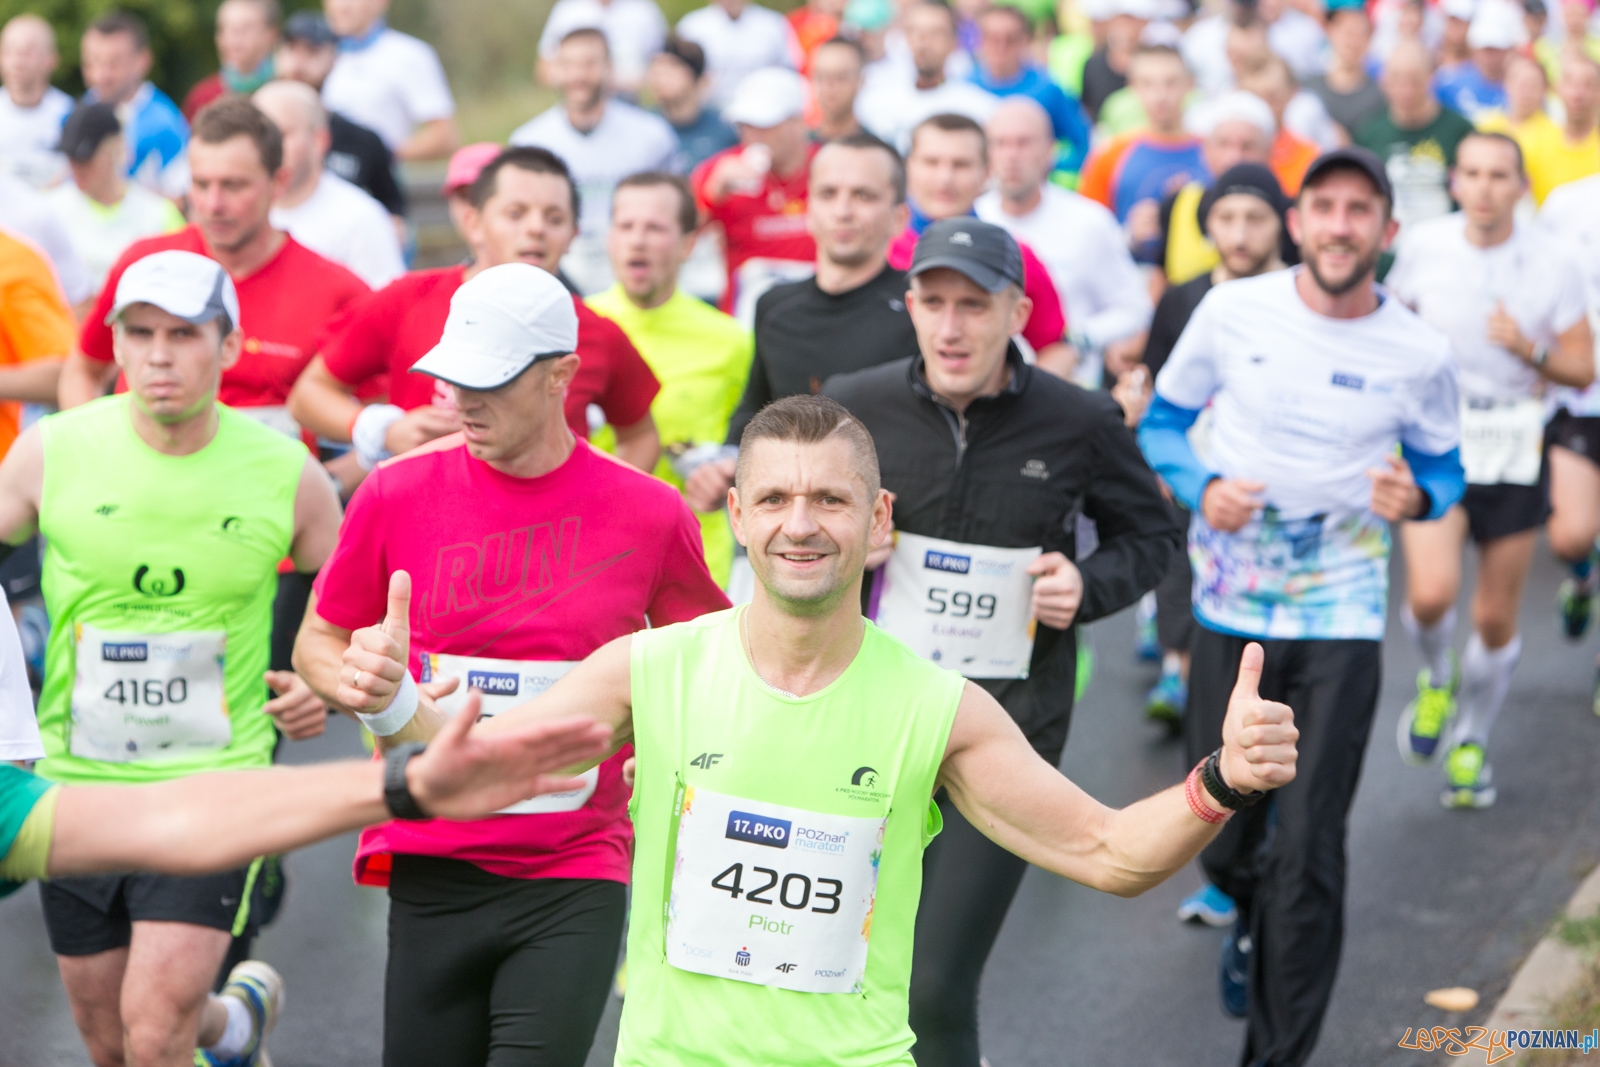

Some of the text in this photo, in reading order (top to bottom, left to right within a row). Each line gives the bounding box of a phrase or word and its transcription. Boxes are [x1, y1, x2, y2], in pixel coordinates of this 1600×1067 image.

[430, 516, 581, 619] RUN
[925, 587, 998, 619] 599
[104, 676, 188, 706] 4160
[488, 676, 516, 691] PKO
[690, 752, 724, 770] 4F
[753, 821, 786, 840] PKO
[794, 838, 845, 853] maraton
[711, 862, 843, 914] 4203
[749, 914, 795, 935] Piotr
